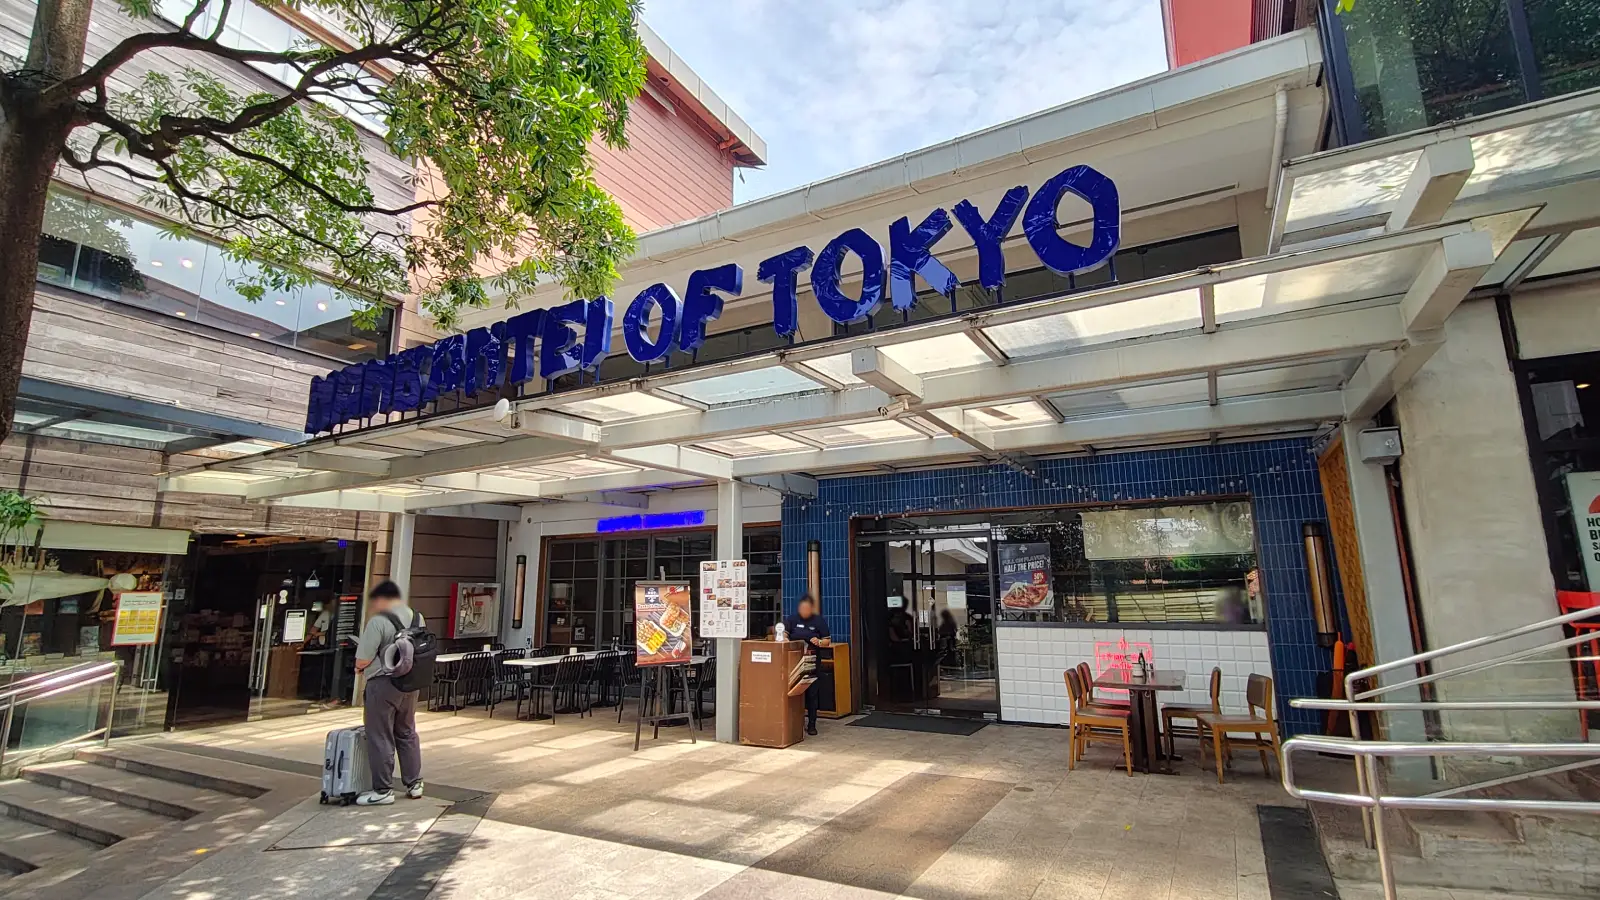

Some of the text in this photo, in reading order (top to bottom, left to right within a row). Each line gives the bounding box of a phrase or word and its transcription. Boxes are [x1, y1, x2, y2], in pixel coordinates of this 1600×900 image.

[623, 263, 743, 364] OF
[757, 164, 1120, 342] TOKYO
[1004, 563, 1017, 573] HALF
[1017, 562, 1028, 571] THE
